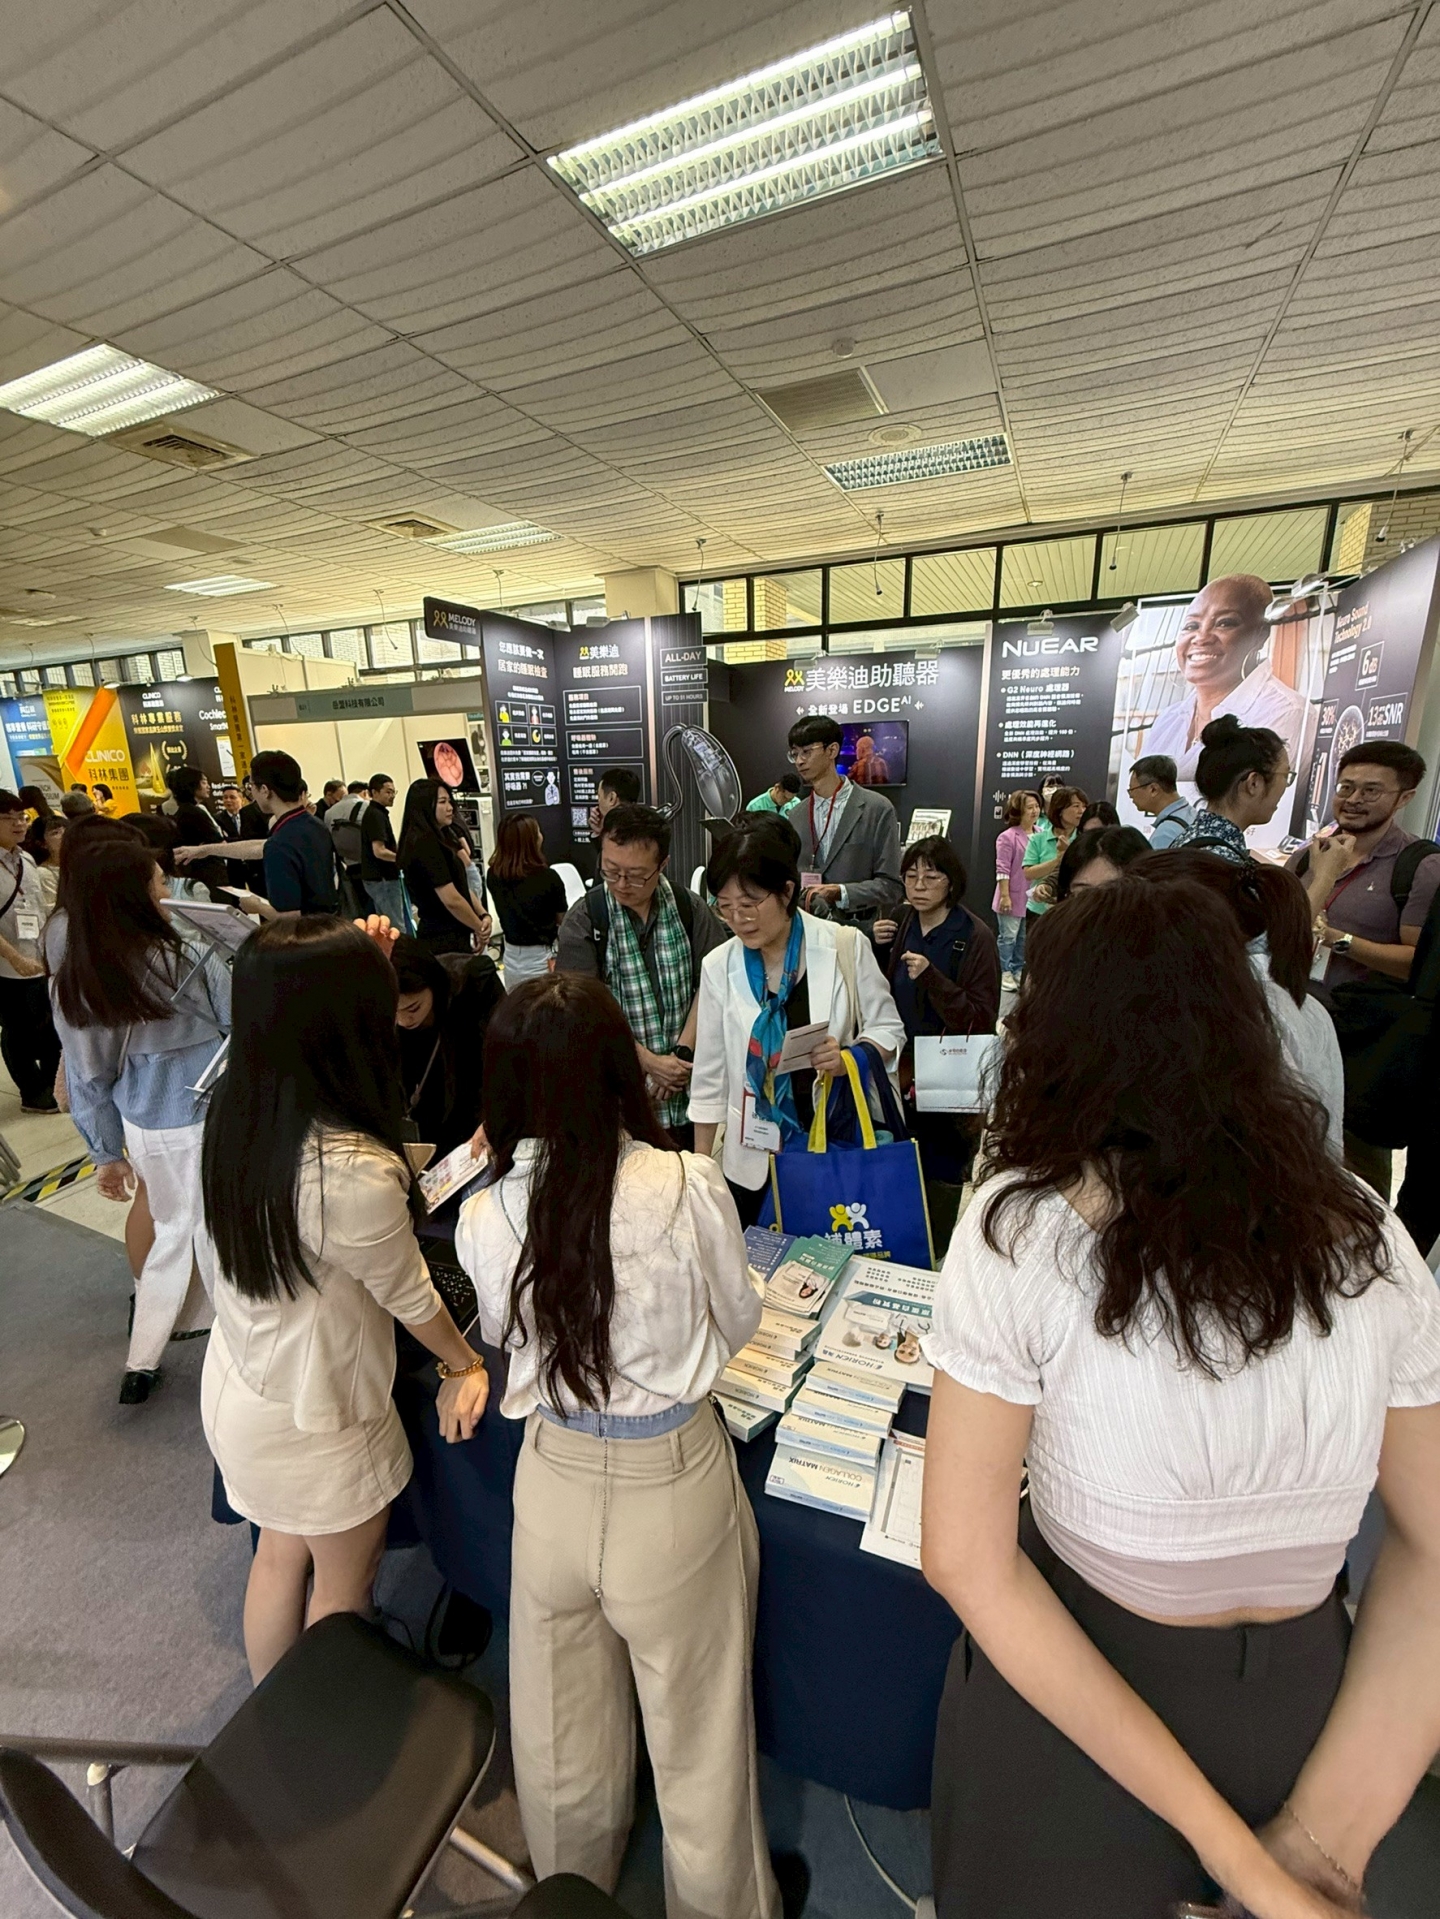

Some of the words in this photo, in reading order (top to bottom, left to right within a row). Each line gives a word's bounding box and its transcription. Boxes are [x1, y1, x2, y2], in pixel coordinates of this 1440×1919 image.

[1351, 601, 1370, 621] Sound
[448, 613, 476, 627] MELODY
[1334, 624, 1361, 644] Technology
[590, 644, 620, 659] 美樂迪
[665, 651, 702, 663] ALL-DAY
[664, 674, 690, 682] BATTERY
[806, 660, 940, 692] 美樂迪助聽器
[1001, 666, 1080, 681] 更優秀的處理能力
[808, 703, 849, 717] 全新登場
[85, 749, 126, 762] CLINICO
[1002, 751, 1019, 759] DNN
[88, 767, 129, 781] 科林集團
[872, 1297, 932, 1316] 原蛋白基質粉
[835, 1353, 875, 1368] HORIEN
[788, 1456, 819, 1470] MATRIX
[819, 1465, 863, 1482] COLLAGEN
